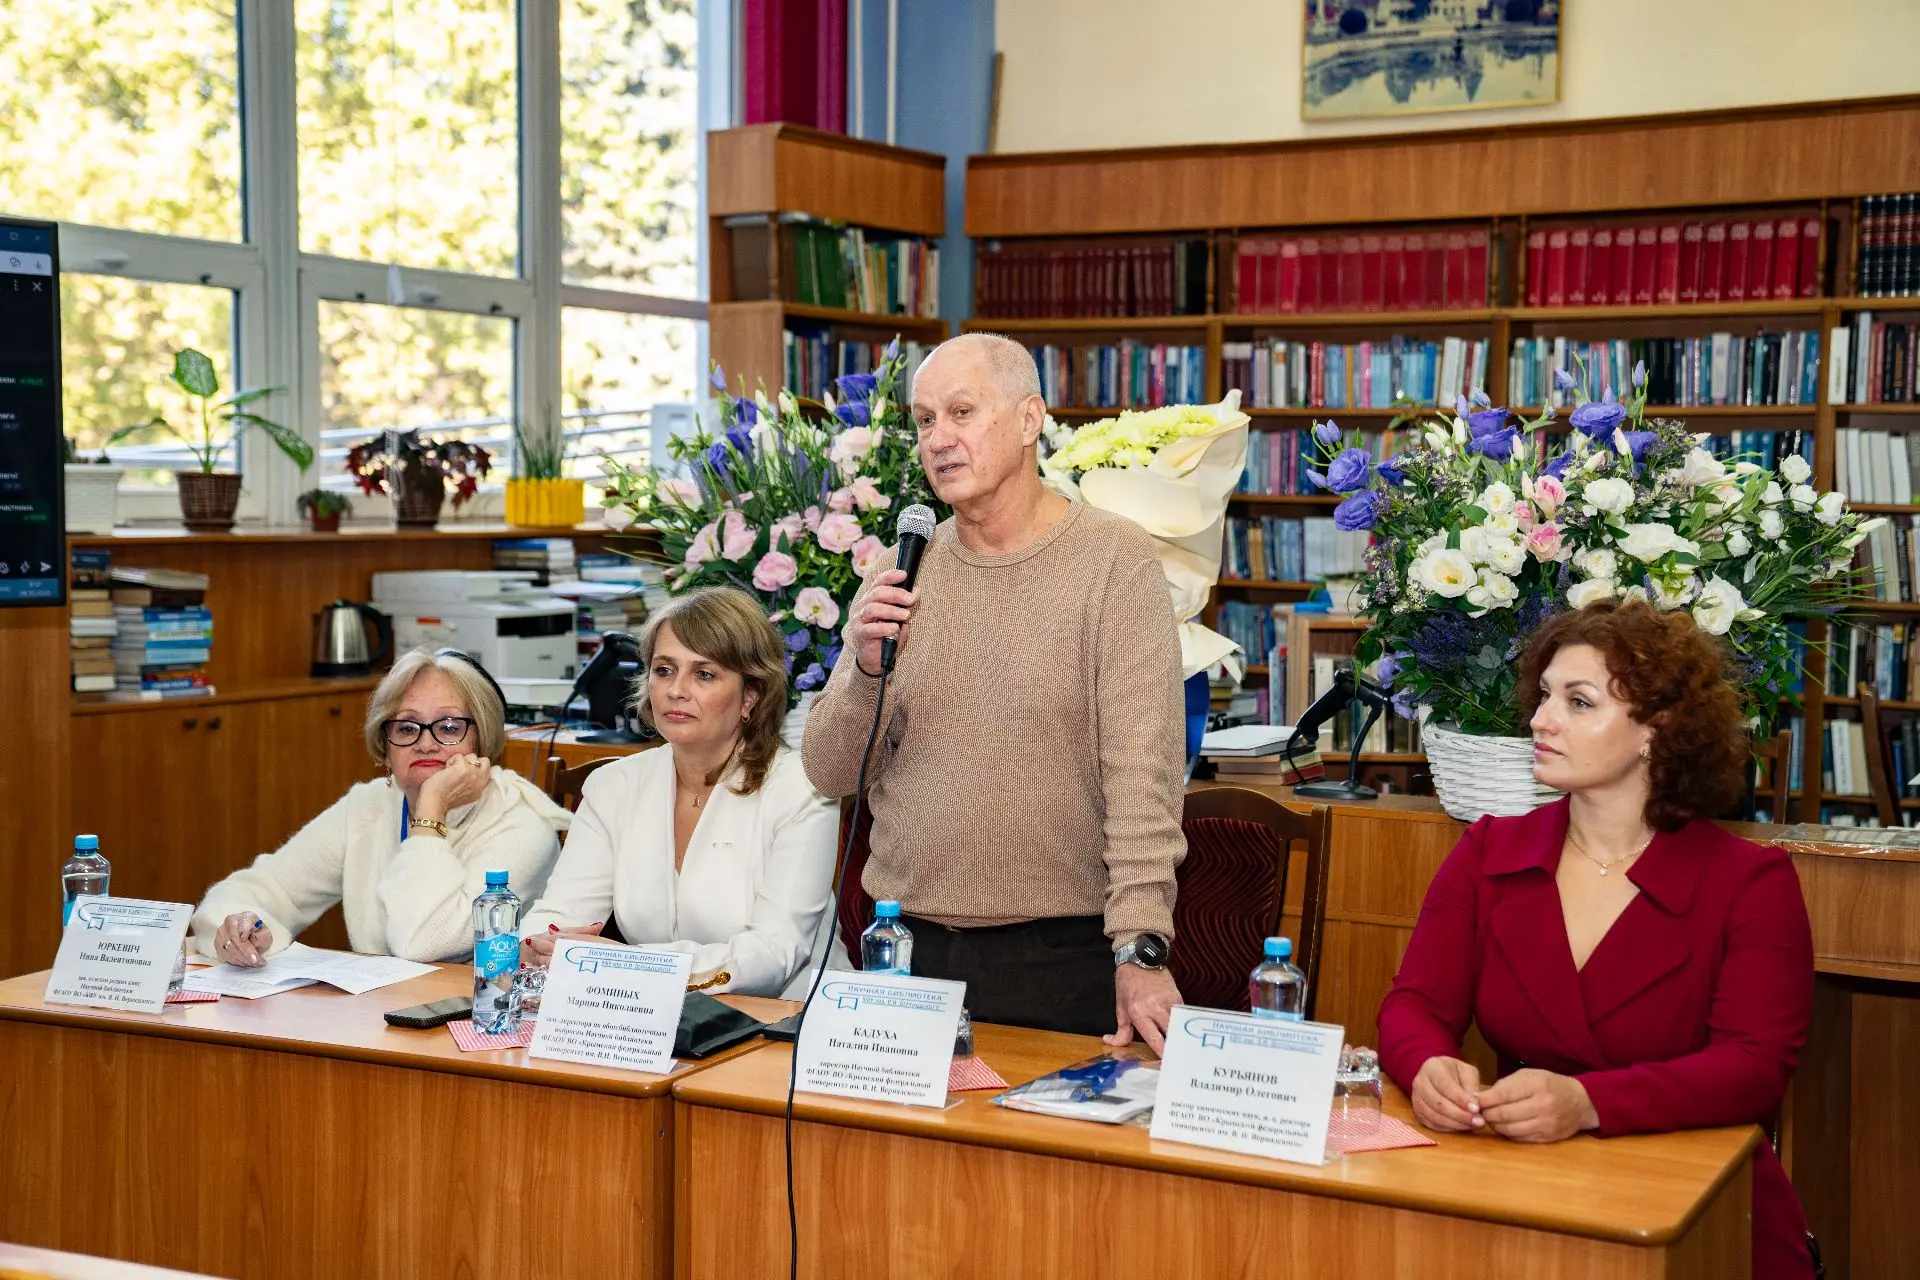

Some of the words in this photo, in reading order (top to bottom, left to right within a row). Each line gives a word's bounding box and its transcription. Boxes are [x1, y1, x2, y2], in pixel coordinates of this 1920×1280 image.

[489, 939, 519, 952] AQUA
[586, 985, 641, 1000] ФОМИНЫХ
[567, 995, 600, 1008] Марина
[602, 1000, 654, 1015] Николаевна
[829, 1038, 869, 1051] Наталия
[871, 1043, 919, 1057] Ивановна
[1213, 1066, 1278, 1085] КУРЬЯНОВ
[1190, 1078, 1243, 1097] Владимир
[1245, 1086, 1297, 1103] Олегович
